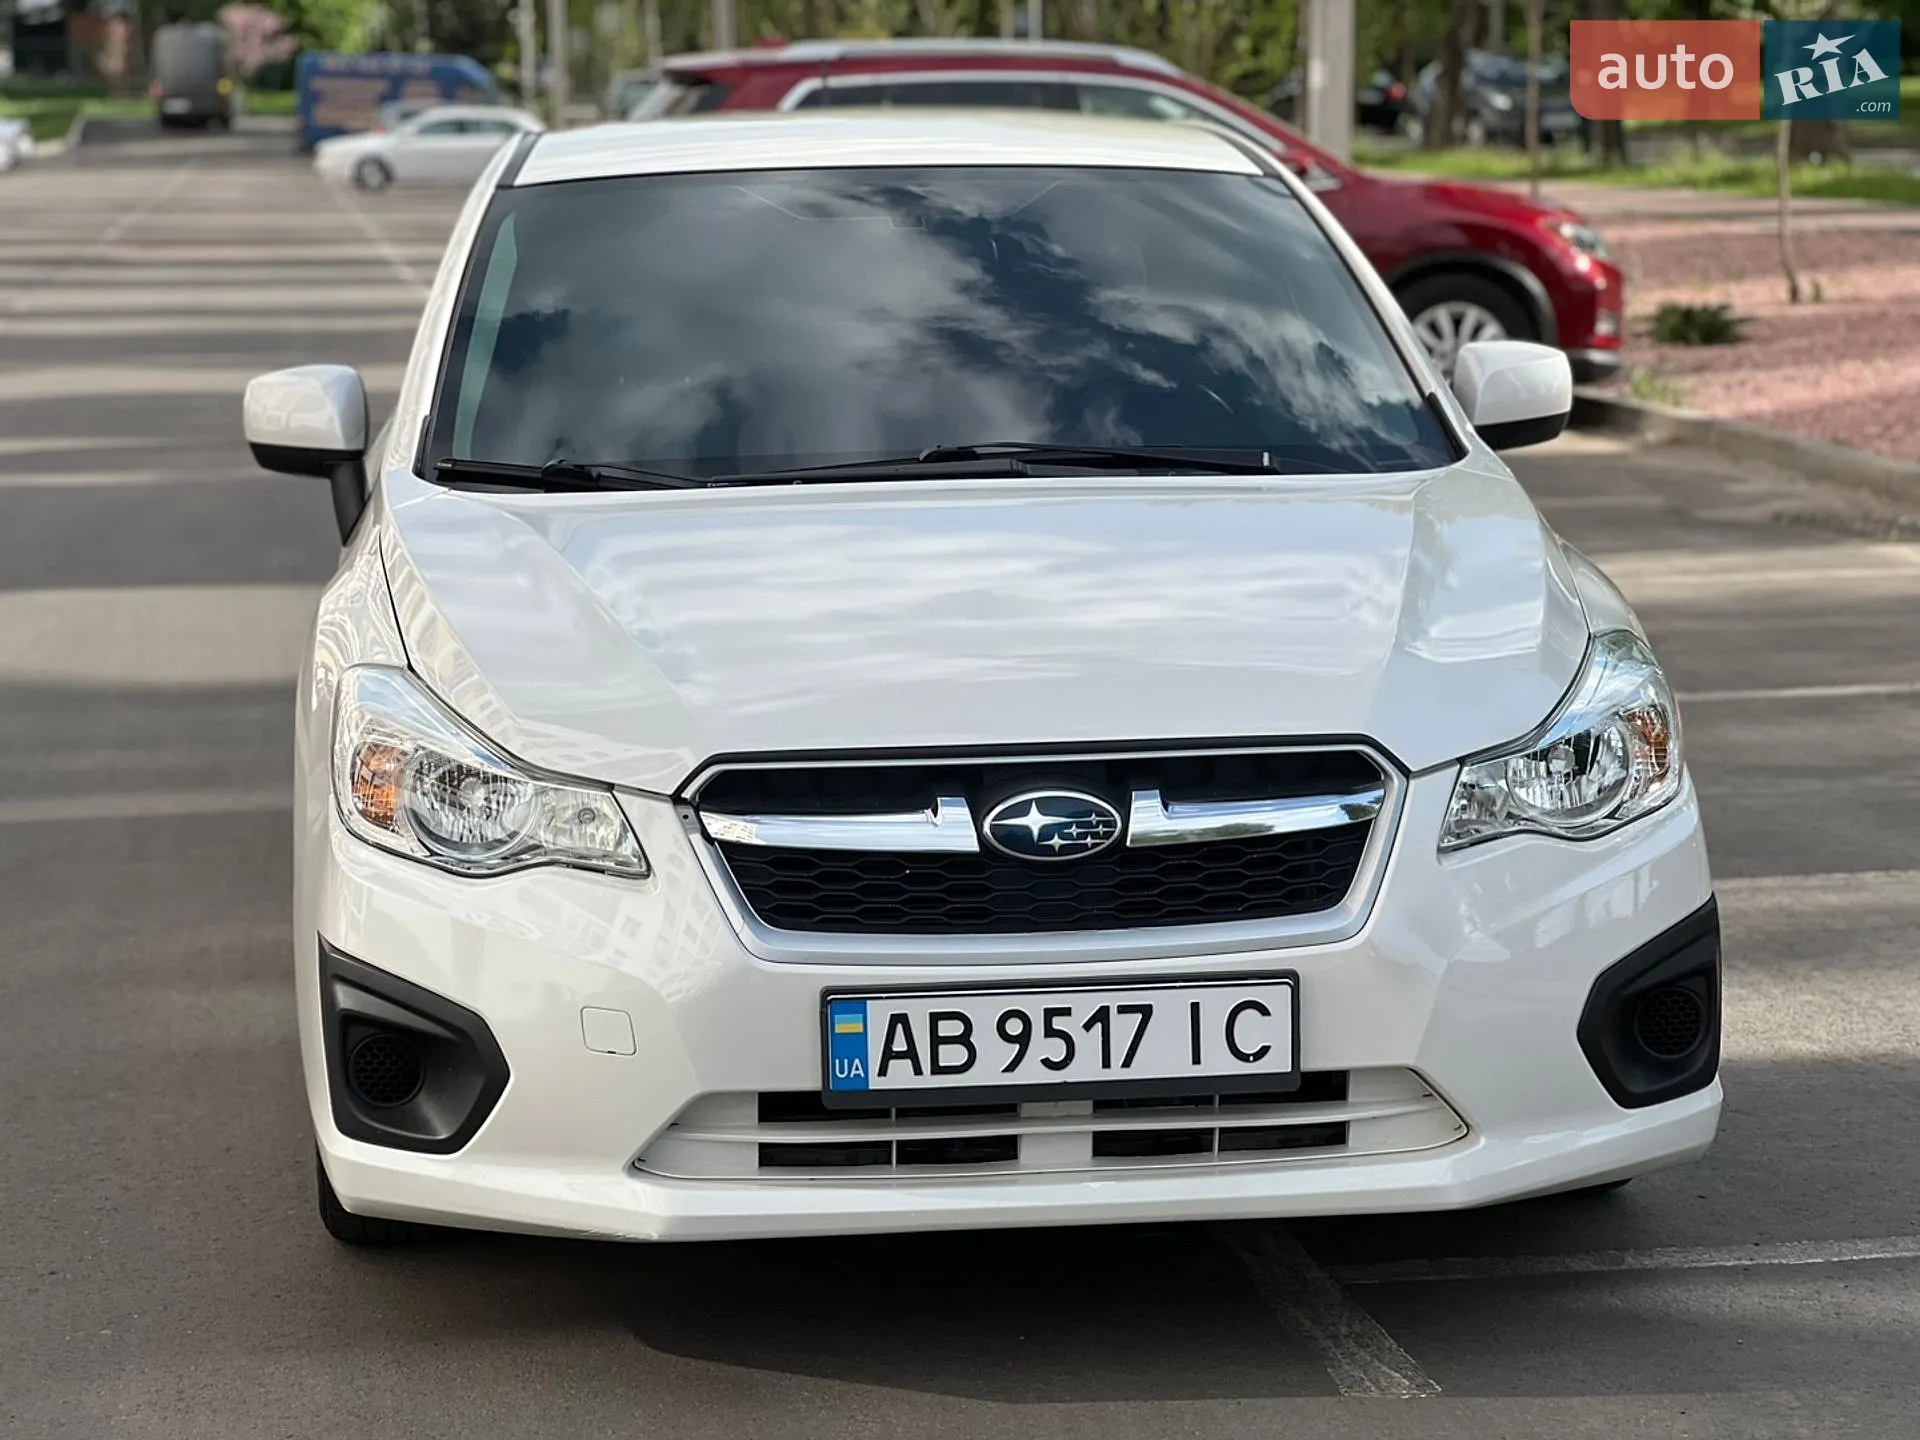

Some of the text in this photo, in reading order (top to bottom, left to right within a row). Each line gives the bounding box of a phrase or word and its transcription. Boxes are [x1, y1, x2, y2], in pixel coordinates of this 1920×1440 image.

[877, 1010, 977, 1077] AB
[996, 1003, 1154, 1073] 9517
[835, 1057, 864, 1079] UA
